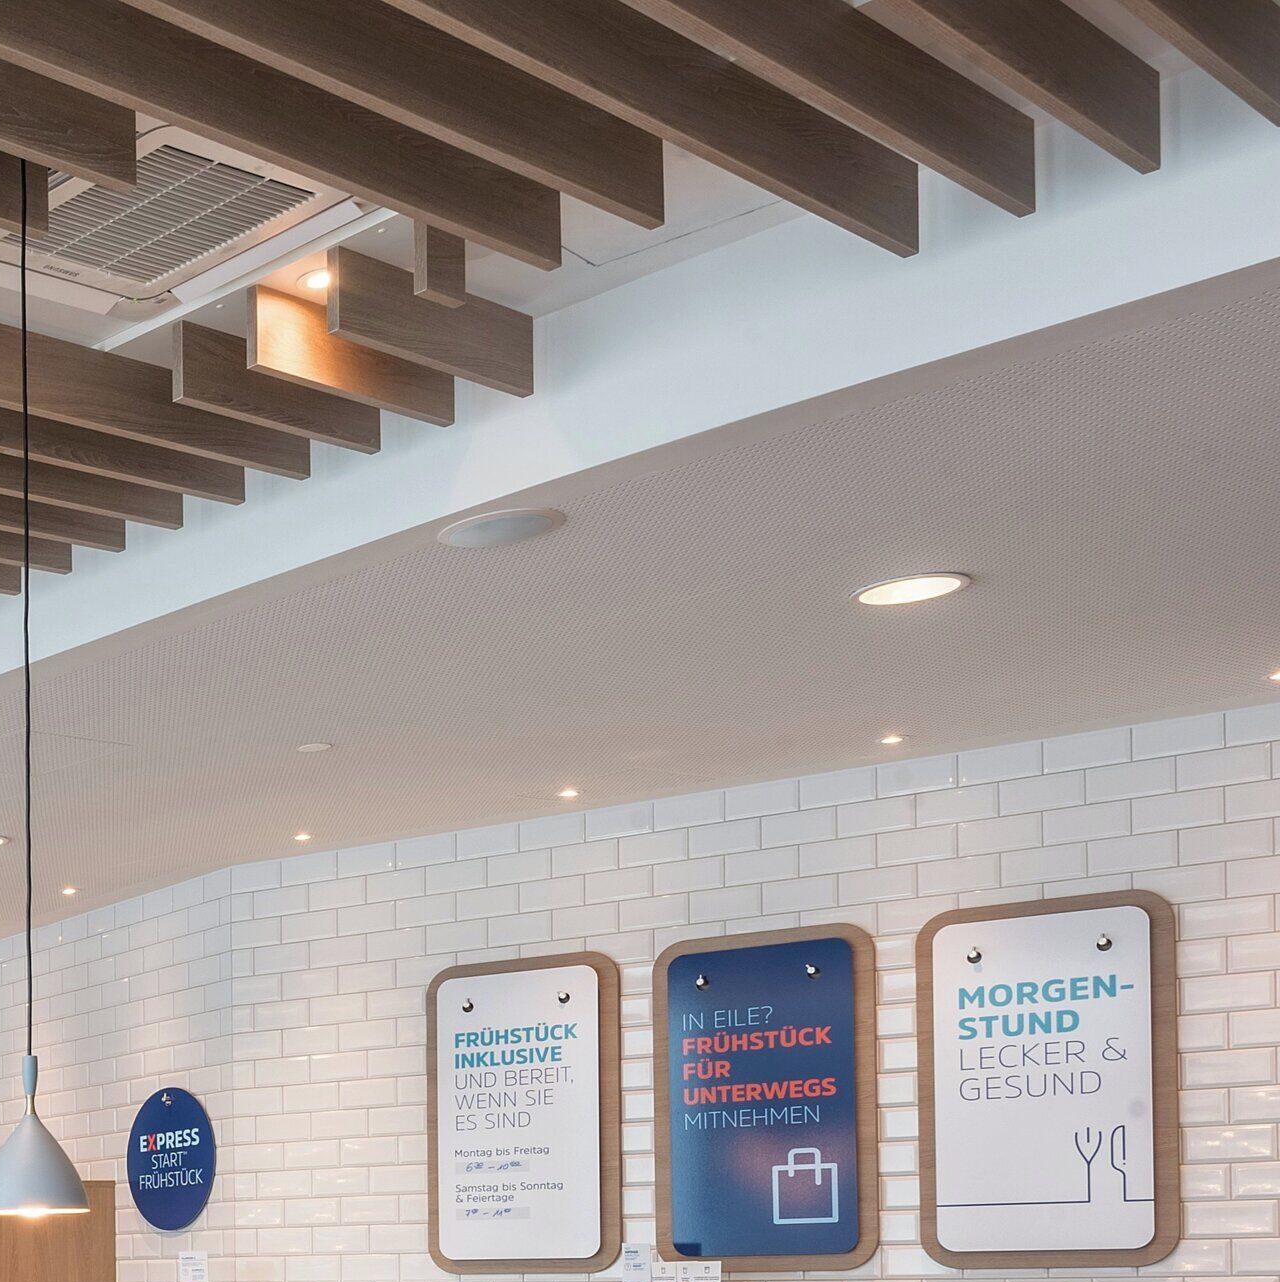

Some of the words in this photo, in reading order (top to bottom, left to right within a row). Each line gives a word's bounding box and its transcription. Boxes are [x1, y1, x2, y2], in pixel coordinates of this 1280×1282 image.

[958, 973, 1134, 1010] MORGEN-
[682, 1012, 704, 1031] IN
[714, 1005, 774, 1029] EILE?
[958, 1009, 1080, 1040] STUND
[455, 1022, 578, 1049] FRÜHSTÜCK
[682, 1025, 832, 1056] FRÜHSTÜCK
[454, 1046, 562, 1069] INKLUSIVE
[959, 1040, 1086, 1071] LECKER
[1101, 1037, 1128, 1061] &
[455, 1071, 497, 1090] UND
[504, 1066, 574, 1087] BEREIT,
[683, 1058, 730, 1080] FÜR
[683, 1077, 837, 1105] UNTERWEGS
[959, 1070, 1102, 1102] GESUND
[454, 1091, 517, 1110] WENN
[525, 1088, 554, 1107] SIE
[455, 1114, 477, 1131] ES
[484, 1111, 531, 1130] SIND
[684, 1105, 821, 1131] MITNEHMEN
[139, 1128, 200, 1153] EXPRESS
[454, 1149, 492, 1158] Montag
[495, 1147, 510, 1156] bis
[513, 1146, 550, 1155] Freitag
[139, 1168, 203, 1191] FRÜHSTÜCK
[455, 1184, 498, 1193] Samstag
[502, 1183, 517, 1192] bis
[520, 1181, 564, 1191] Sonntag
[455, 1195, 463, 1203] &
[466, 1193, 515, 1203] Feiertage
